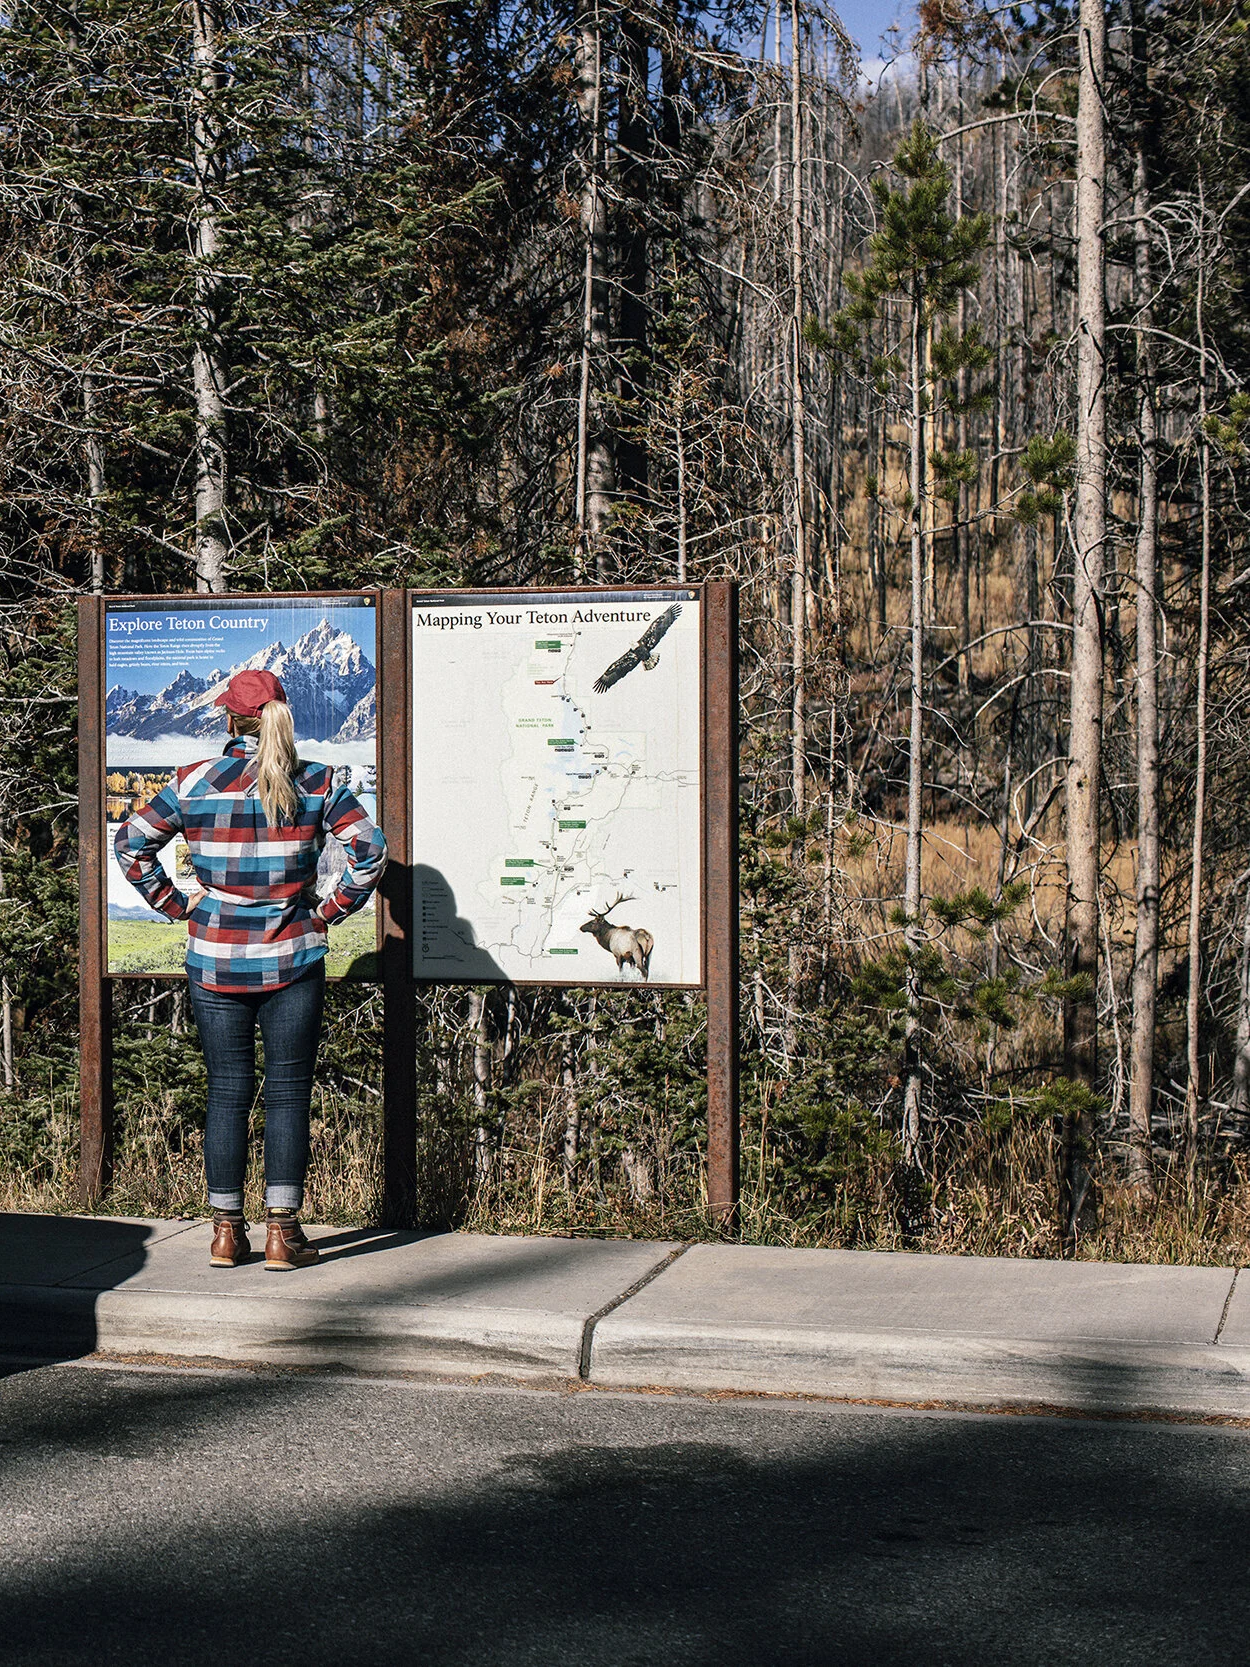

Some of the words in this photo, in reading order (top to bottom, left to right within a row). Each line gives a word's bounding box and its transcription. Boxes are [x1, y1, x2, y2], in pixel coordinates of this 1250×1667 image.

[109, 617, 163, 635] Explore
[166, 617, 205, 630] Teton
[210, 615, 269, 632] Country
[416, 612, 482, 630] Mapping
[486, 612, 522, 624] Your
[526, 610, 568, 624] Teton
[572, 609, 651, 623] Adventure
